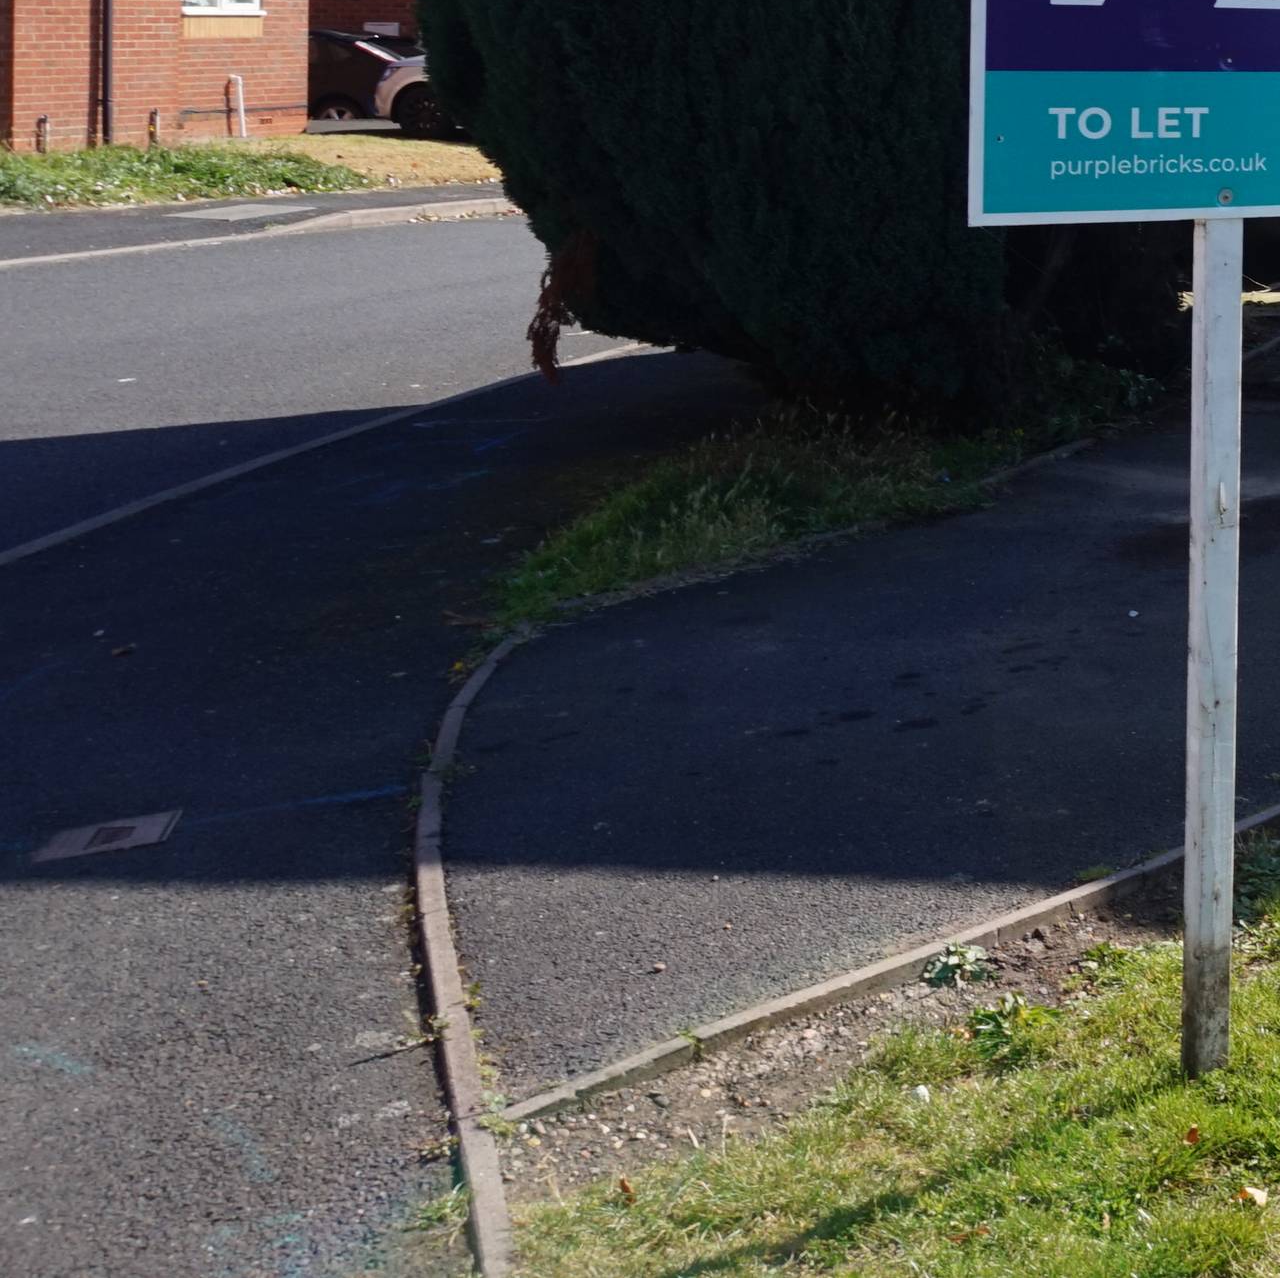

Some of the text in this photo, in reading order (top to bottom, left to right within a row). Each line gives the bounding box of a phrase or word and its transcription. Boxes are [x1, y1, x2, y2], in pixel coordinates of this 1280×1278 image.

[1048, 106, 1209, 140] TO LET
[1050, 152, 1267, 180] purplebricks.co.uk
